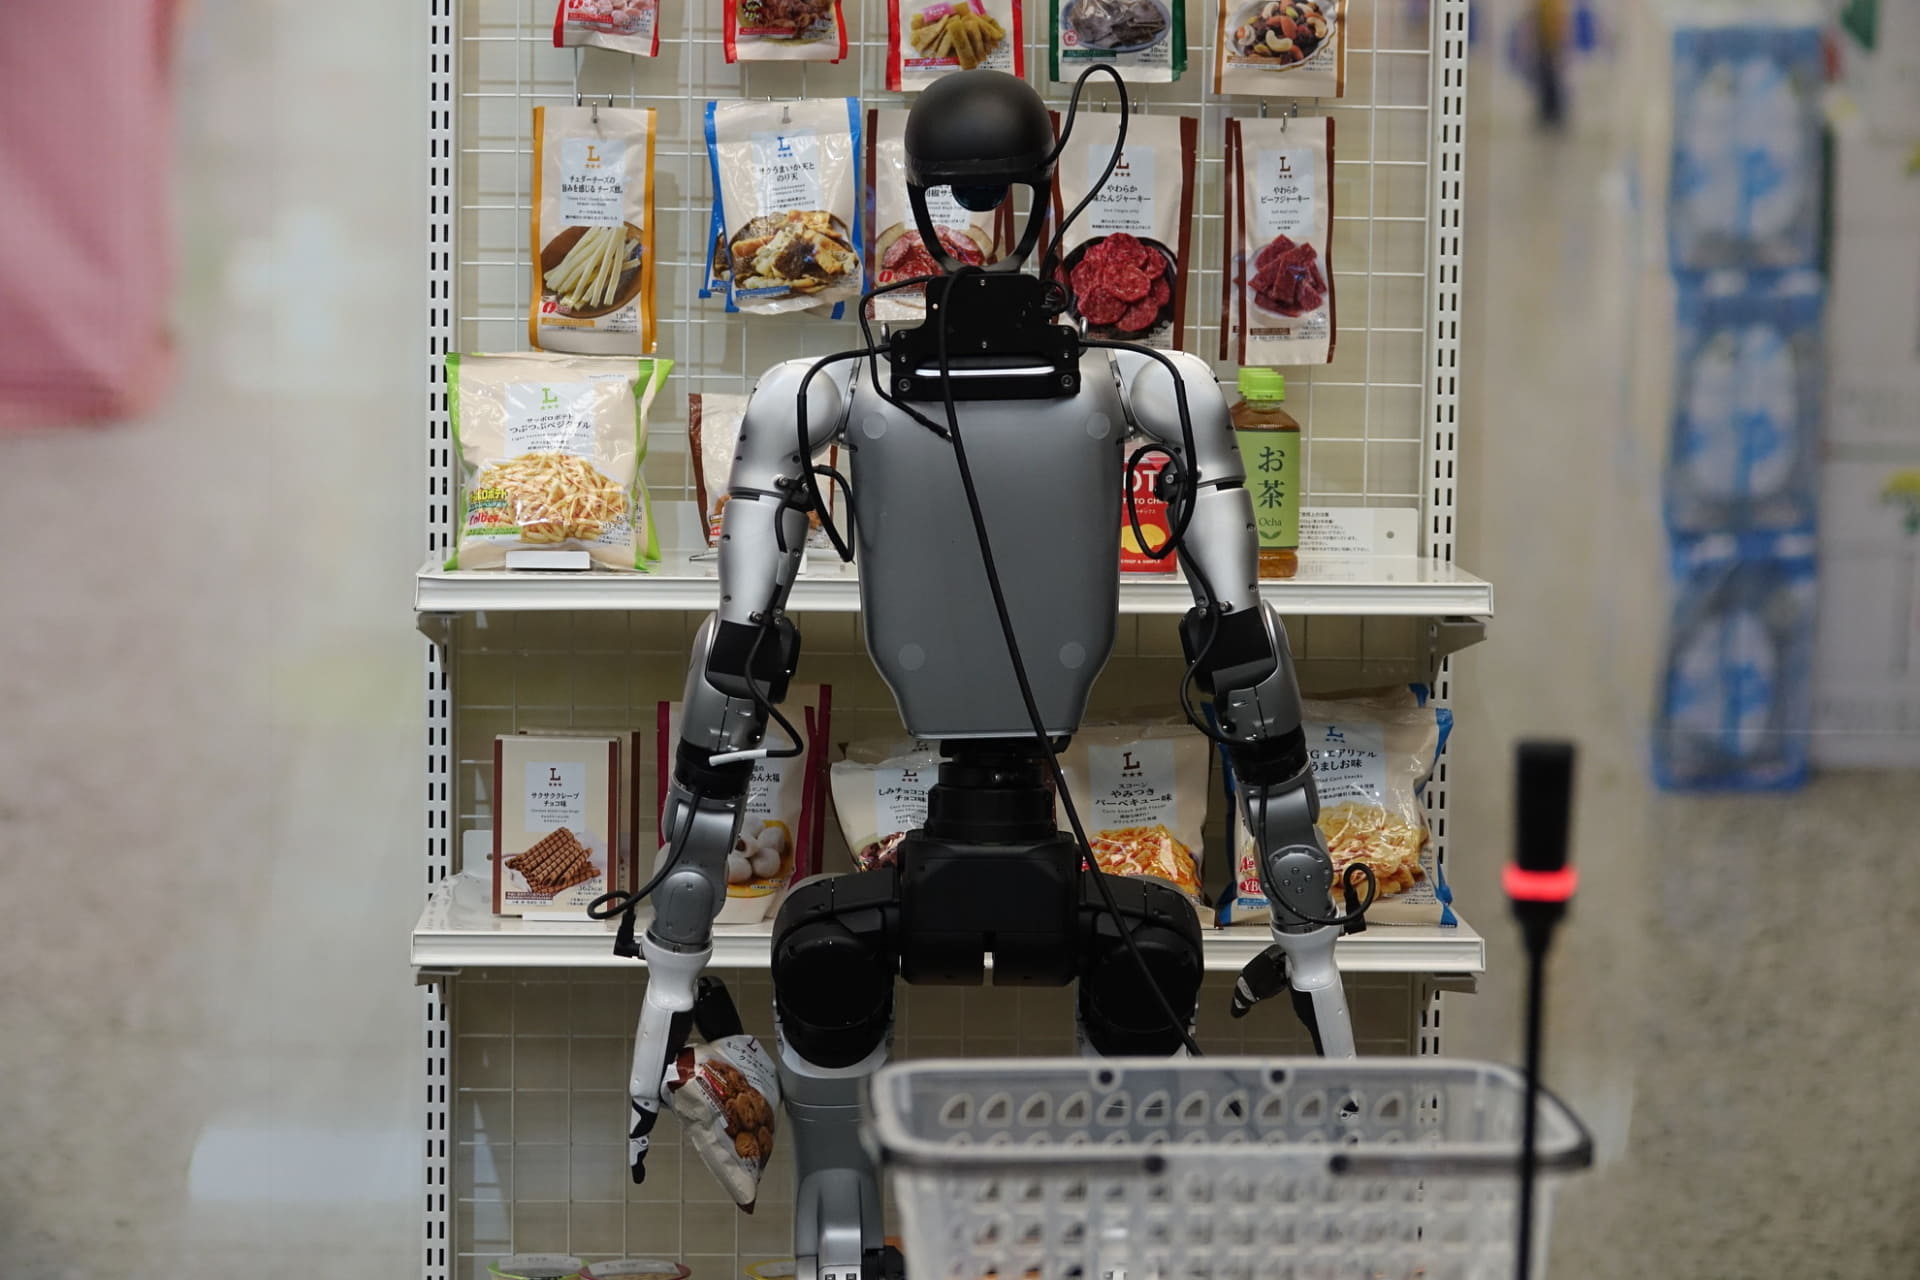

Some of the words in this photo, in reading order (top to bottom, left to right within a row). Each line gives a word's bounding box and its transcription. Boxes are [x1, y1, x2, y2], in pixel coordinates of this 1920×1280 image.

[777, 136, 791, 151] L
[586, 145, 600, 162] L
[1279, 156, 1291, 172] L
[1107, 184, 1138, 193] やわらか
[1273, 186, 1299, 195] やわらか
[1261, 195, 1310, 204] ビーフジャーキー
[541, 387, 558, 404] L
[1257, 446, 1285, 509] お茶
[1258, 516, 1282, 527] Ocha
[1325, 726, 1344, 738] L
[1327, 748, 1377, 759] エアリアル
[1123, 752, 1140, 771] L
[550, 767, 561, 781] L
[531, 791, 580, 800] サクサククレープ
[1095, 793, 1173, 807] バーベキュー味
[1111, 788, 1155, 799] やみつき
